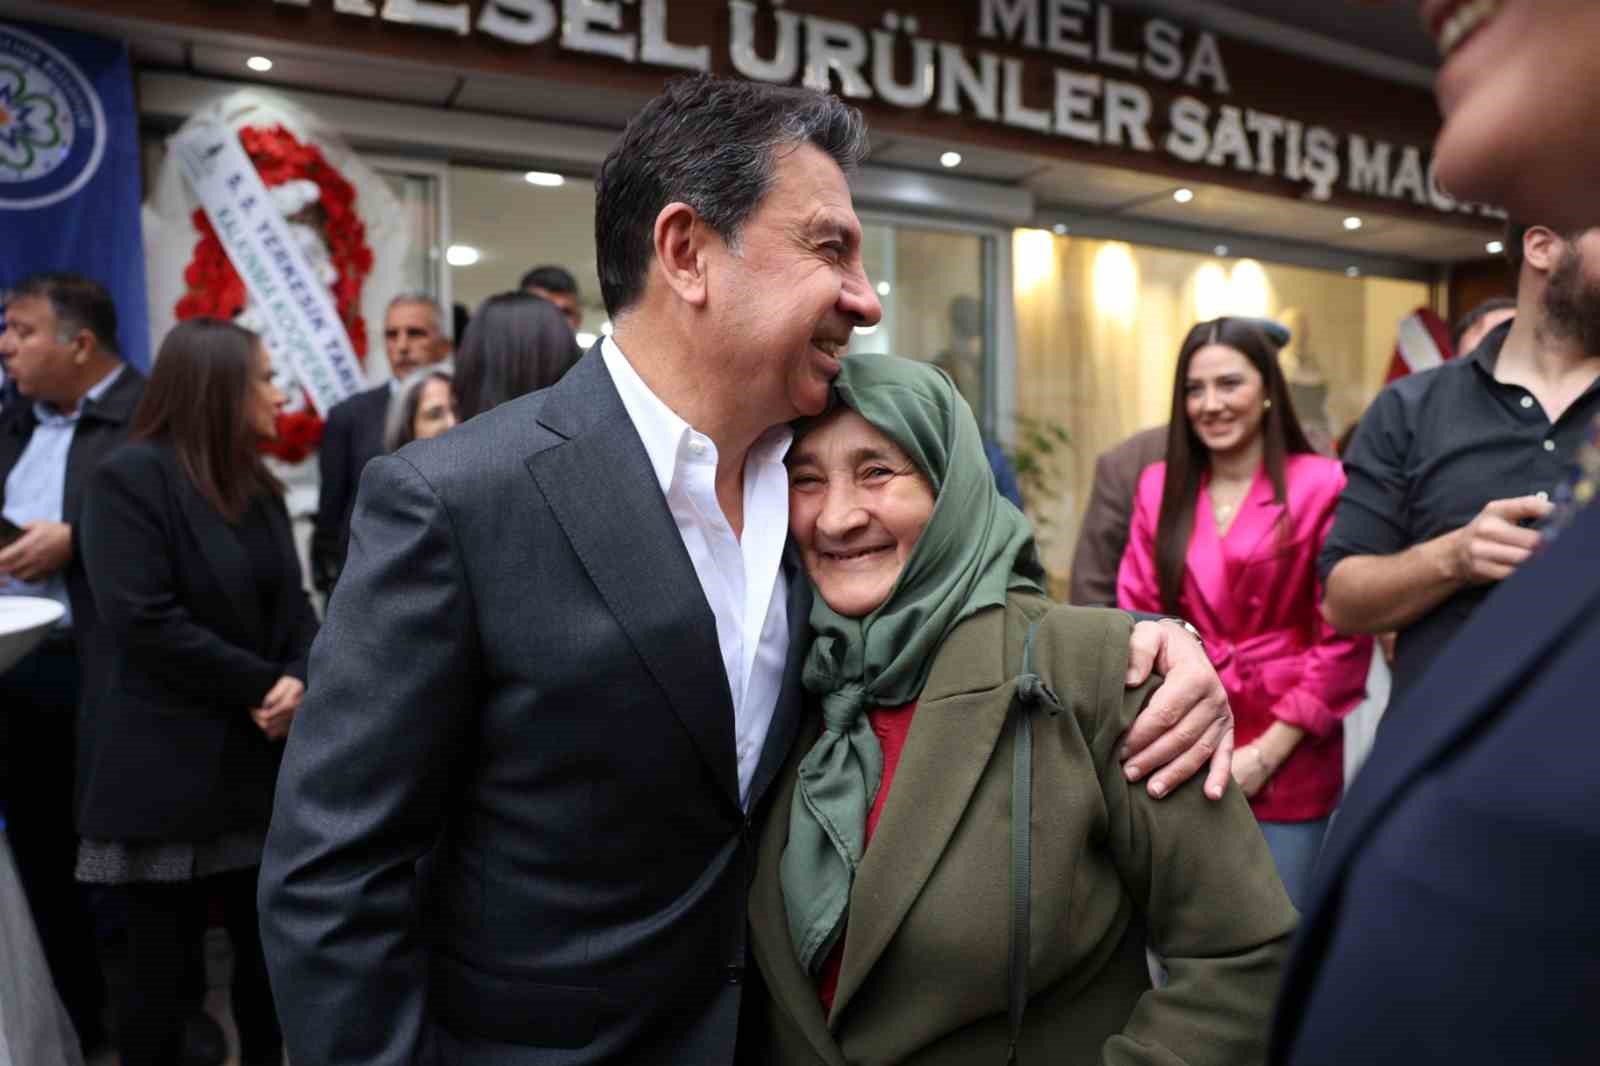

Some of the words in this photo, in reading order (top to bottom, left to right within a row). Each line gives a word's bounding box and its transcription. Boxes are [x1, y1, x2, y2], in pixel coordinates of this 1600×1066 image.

[727, 0, 1153, 150] ÜRÜNLER
[1165, 96, 1340, 199] SATIŞ
[978, 0, 1229, 94] MELSA
